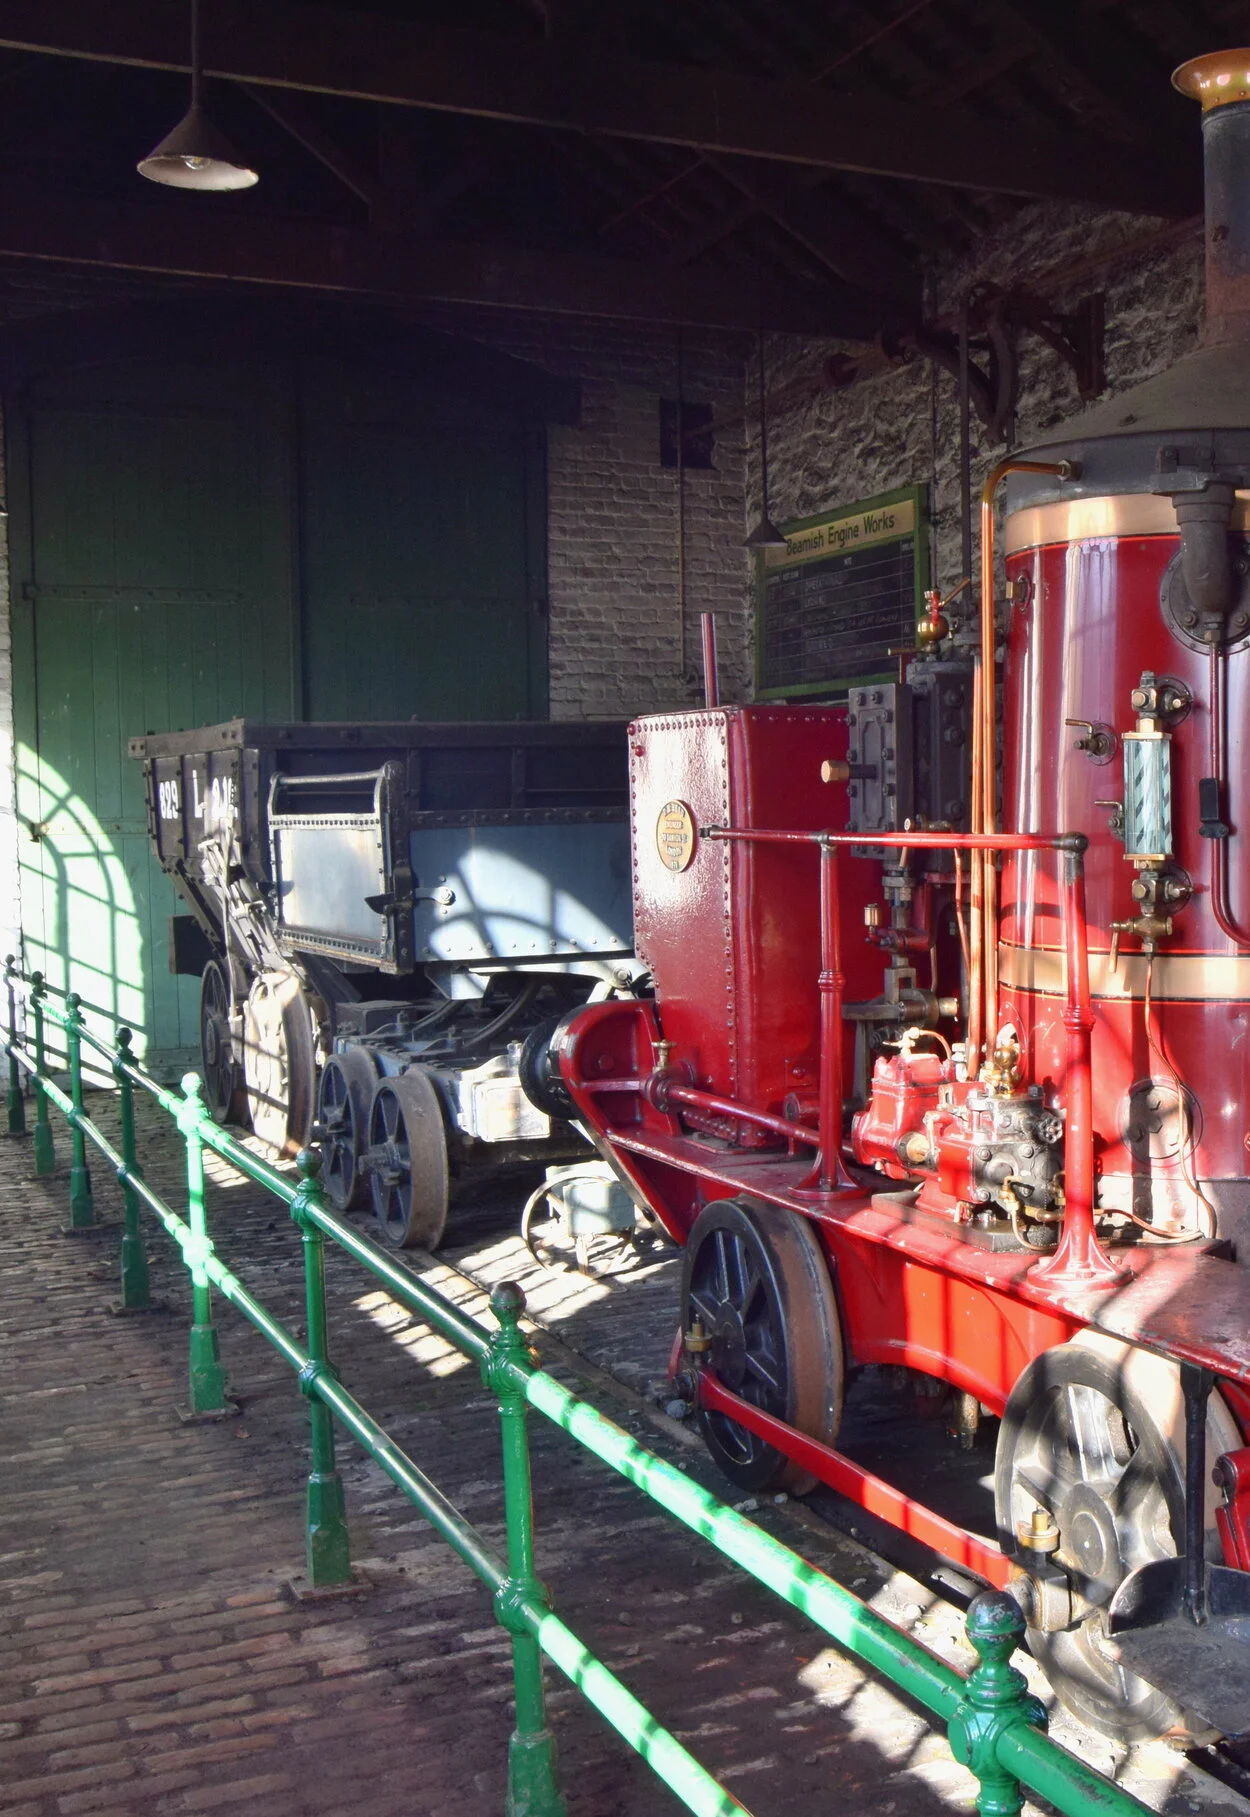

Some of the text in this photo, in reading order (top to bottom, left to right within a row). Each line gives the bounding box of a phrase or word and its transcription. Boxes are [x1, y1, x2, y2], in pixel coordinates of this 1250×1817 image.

[786, 511, 895, 556] Beamish Engine Works
[159, 780, 179, 819] 829
